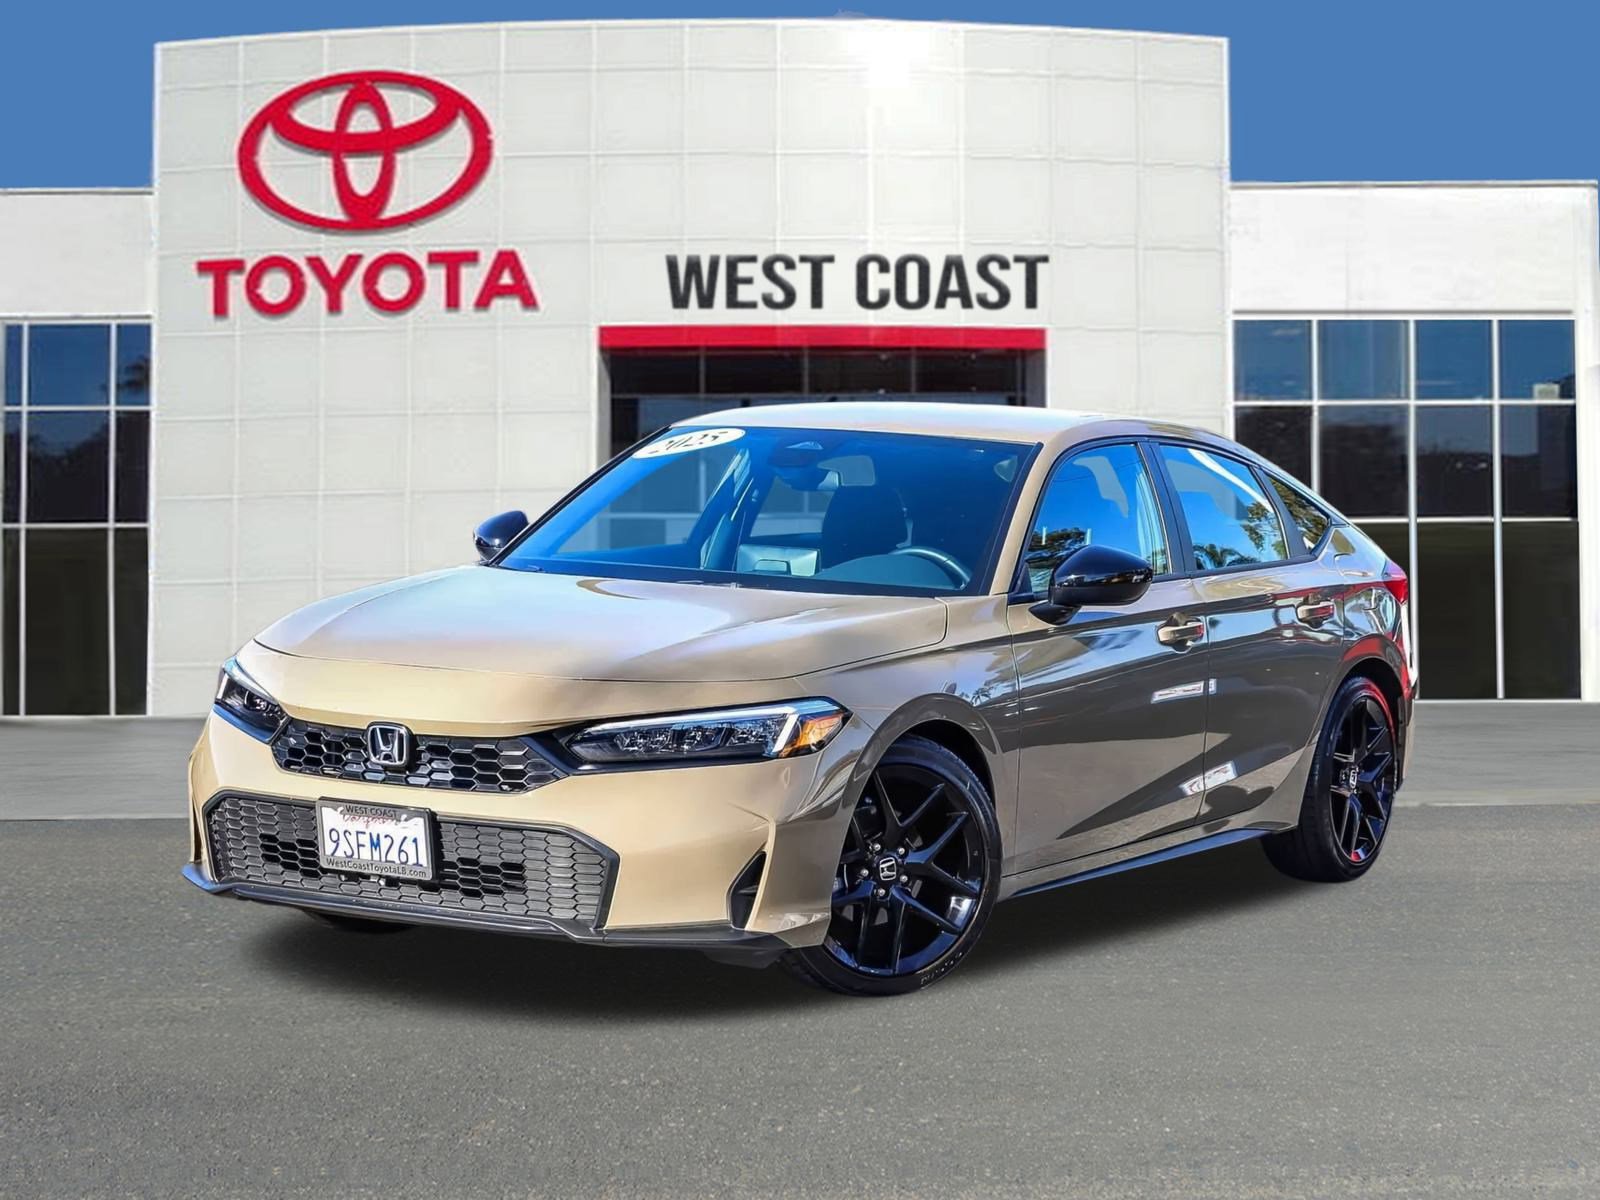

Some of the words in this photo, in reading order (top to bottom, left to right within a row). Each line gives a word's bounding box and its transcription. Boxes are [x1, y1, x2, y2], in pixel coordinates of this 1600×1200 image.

[196, 250, 539, 317] TOYOTA
[665, 253, 835, 310] WEST
[855, 253, 1049, 310] COAST
[345, 804, 368, 815] WEST
[369, 807, 397, 819] COAST
[326, 857, 427, 878] WestCoastToyotaLB.com
[328, 827, 423, 868] 9SFM261
